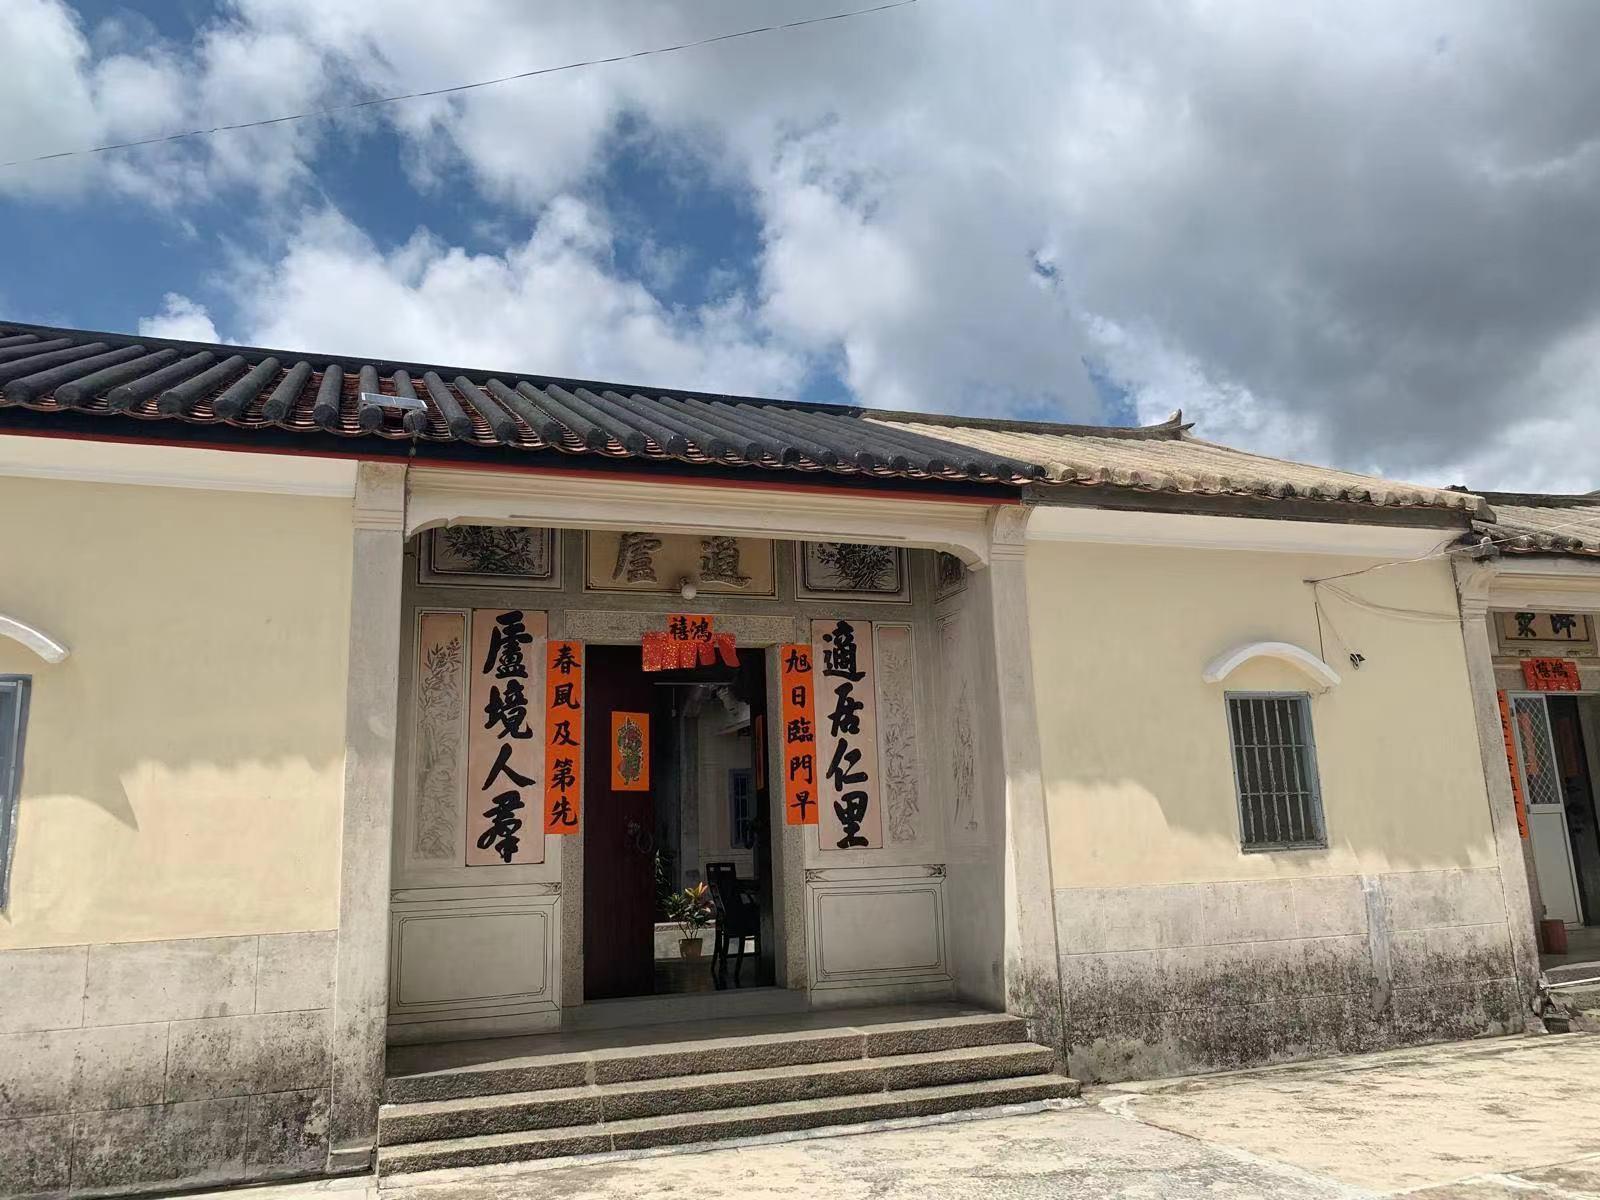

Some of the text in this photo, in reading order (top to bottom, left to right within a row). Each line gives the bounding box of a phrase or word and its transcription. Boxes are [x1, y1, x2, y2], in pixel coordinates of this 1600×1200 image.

[550, 643, 581, 827] 春風及第先
[784, 649, 816, 822] 旭日臨門早
[822, 620, 870, 849] 適居仁里
